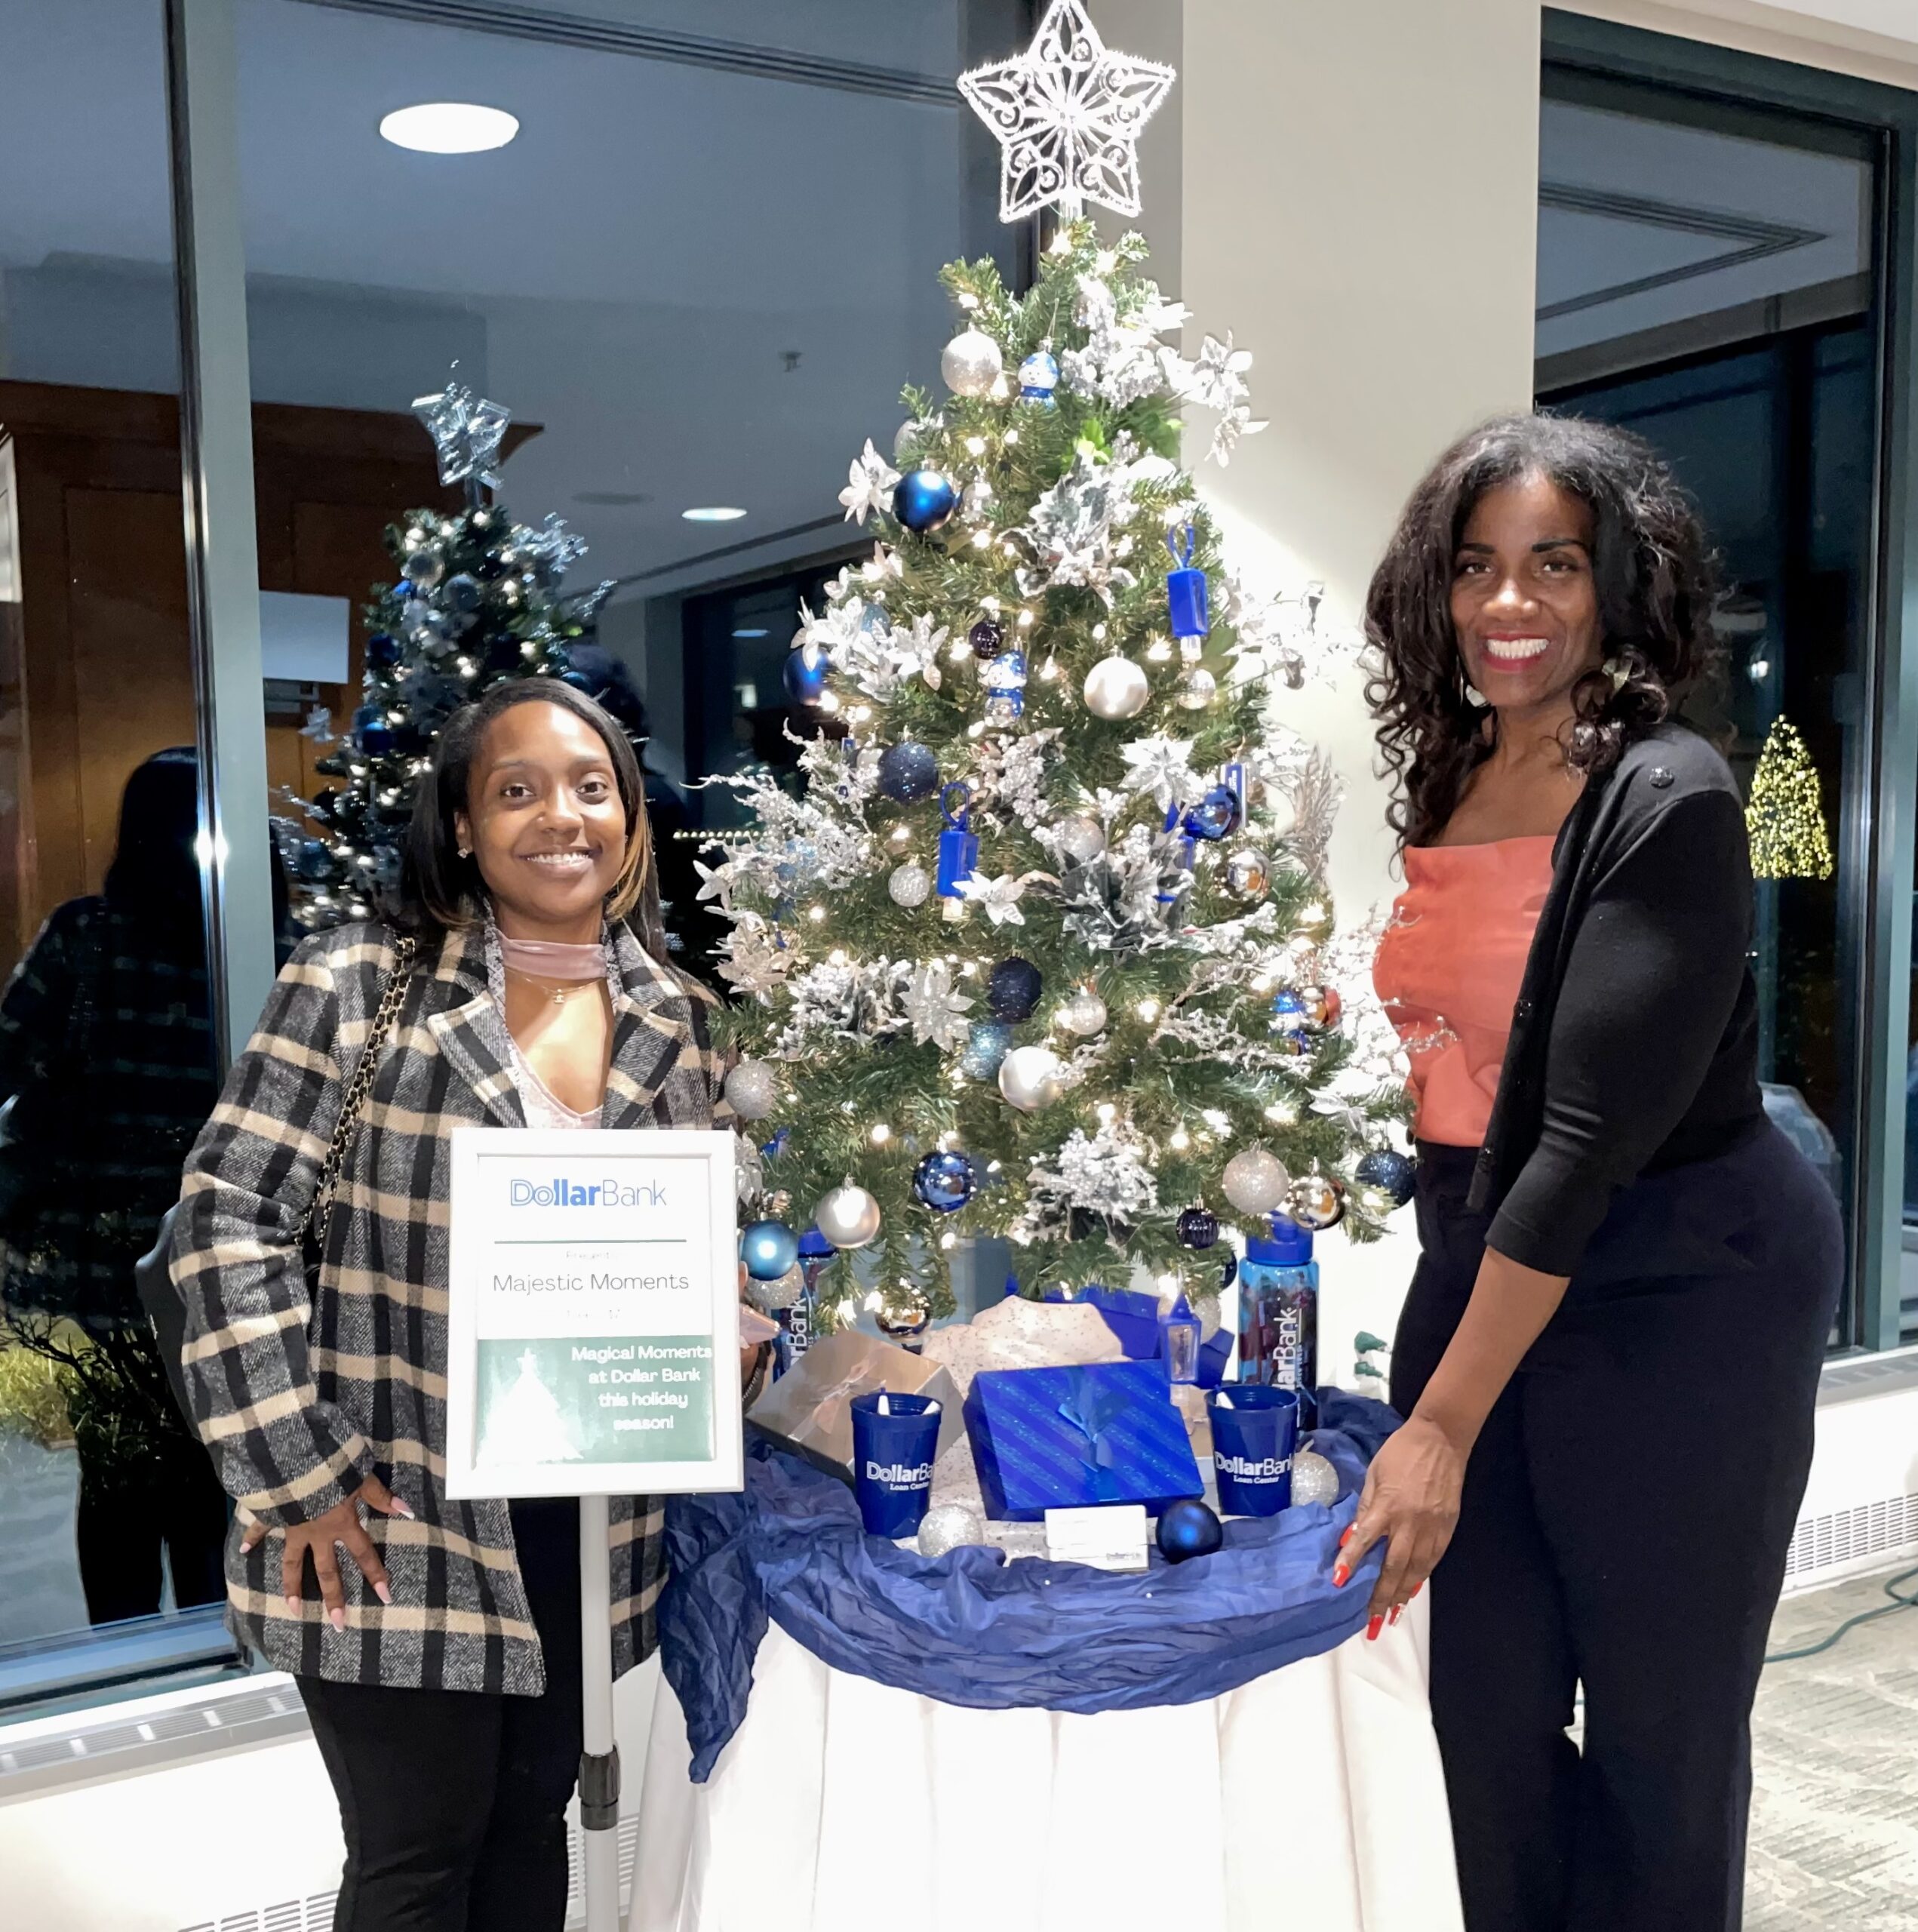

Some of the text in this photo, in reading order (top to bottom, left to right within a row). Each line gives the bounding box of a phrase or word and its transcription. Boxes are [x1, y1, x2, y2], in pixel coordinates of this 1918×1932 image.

[510, 1179, 667, 1206] DollarBank
[493, 1273, 690, 1296] Majestic Moments
[571, 1345, 713, 1364] Magical Moments
[1272, 1308, 1296, 1389] larBank
[589, 1367, 701, 1384] at Dollar Bank
[598, 1392, 689, 1409] this holiday
[613, 1415, 675, 1430] season!
[866, 1460, 933, 1482] DollarBa
[1232, 1475, 1280, 1484] Loan Center
[890, 1483, 909, 1491] Loan
